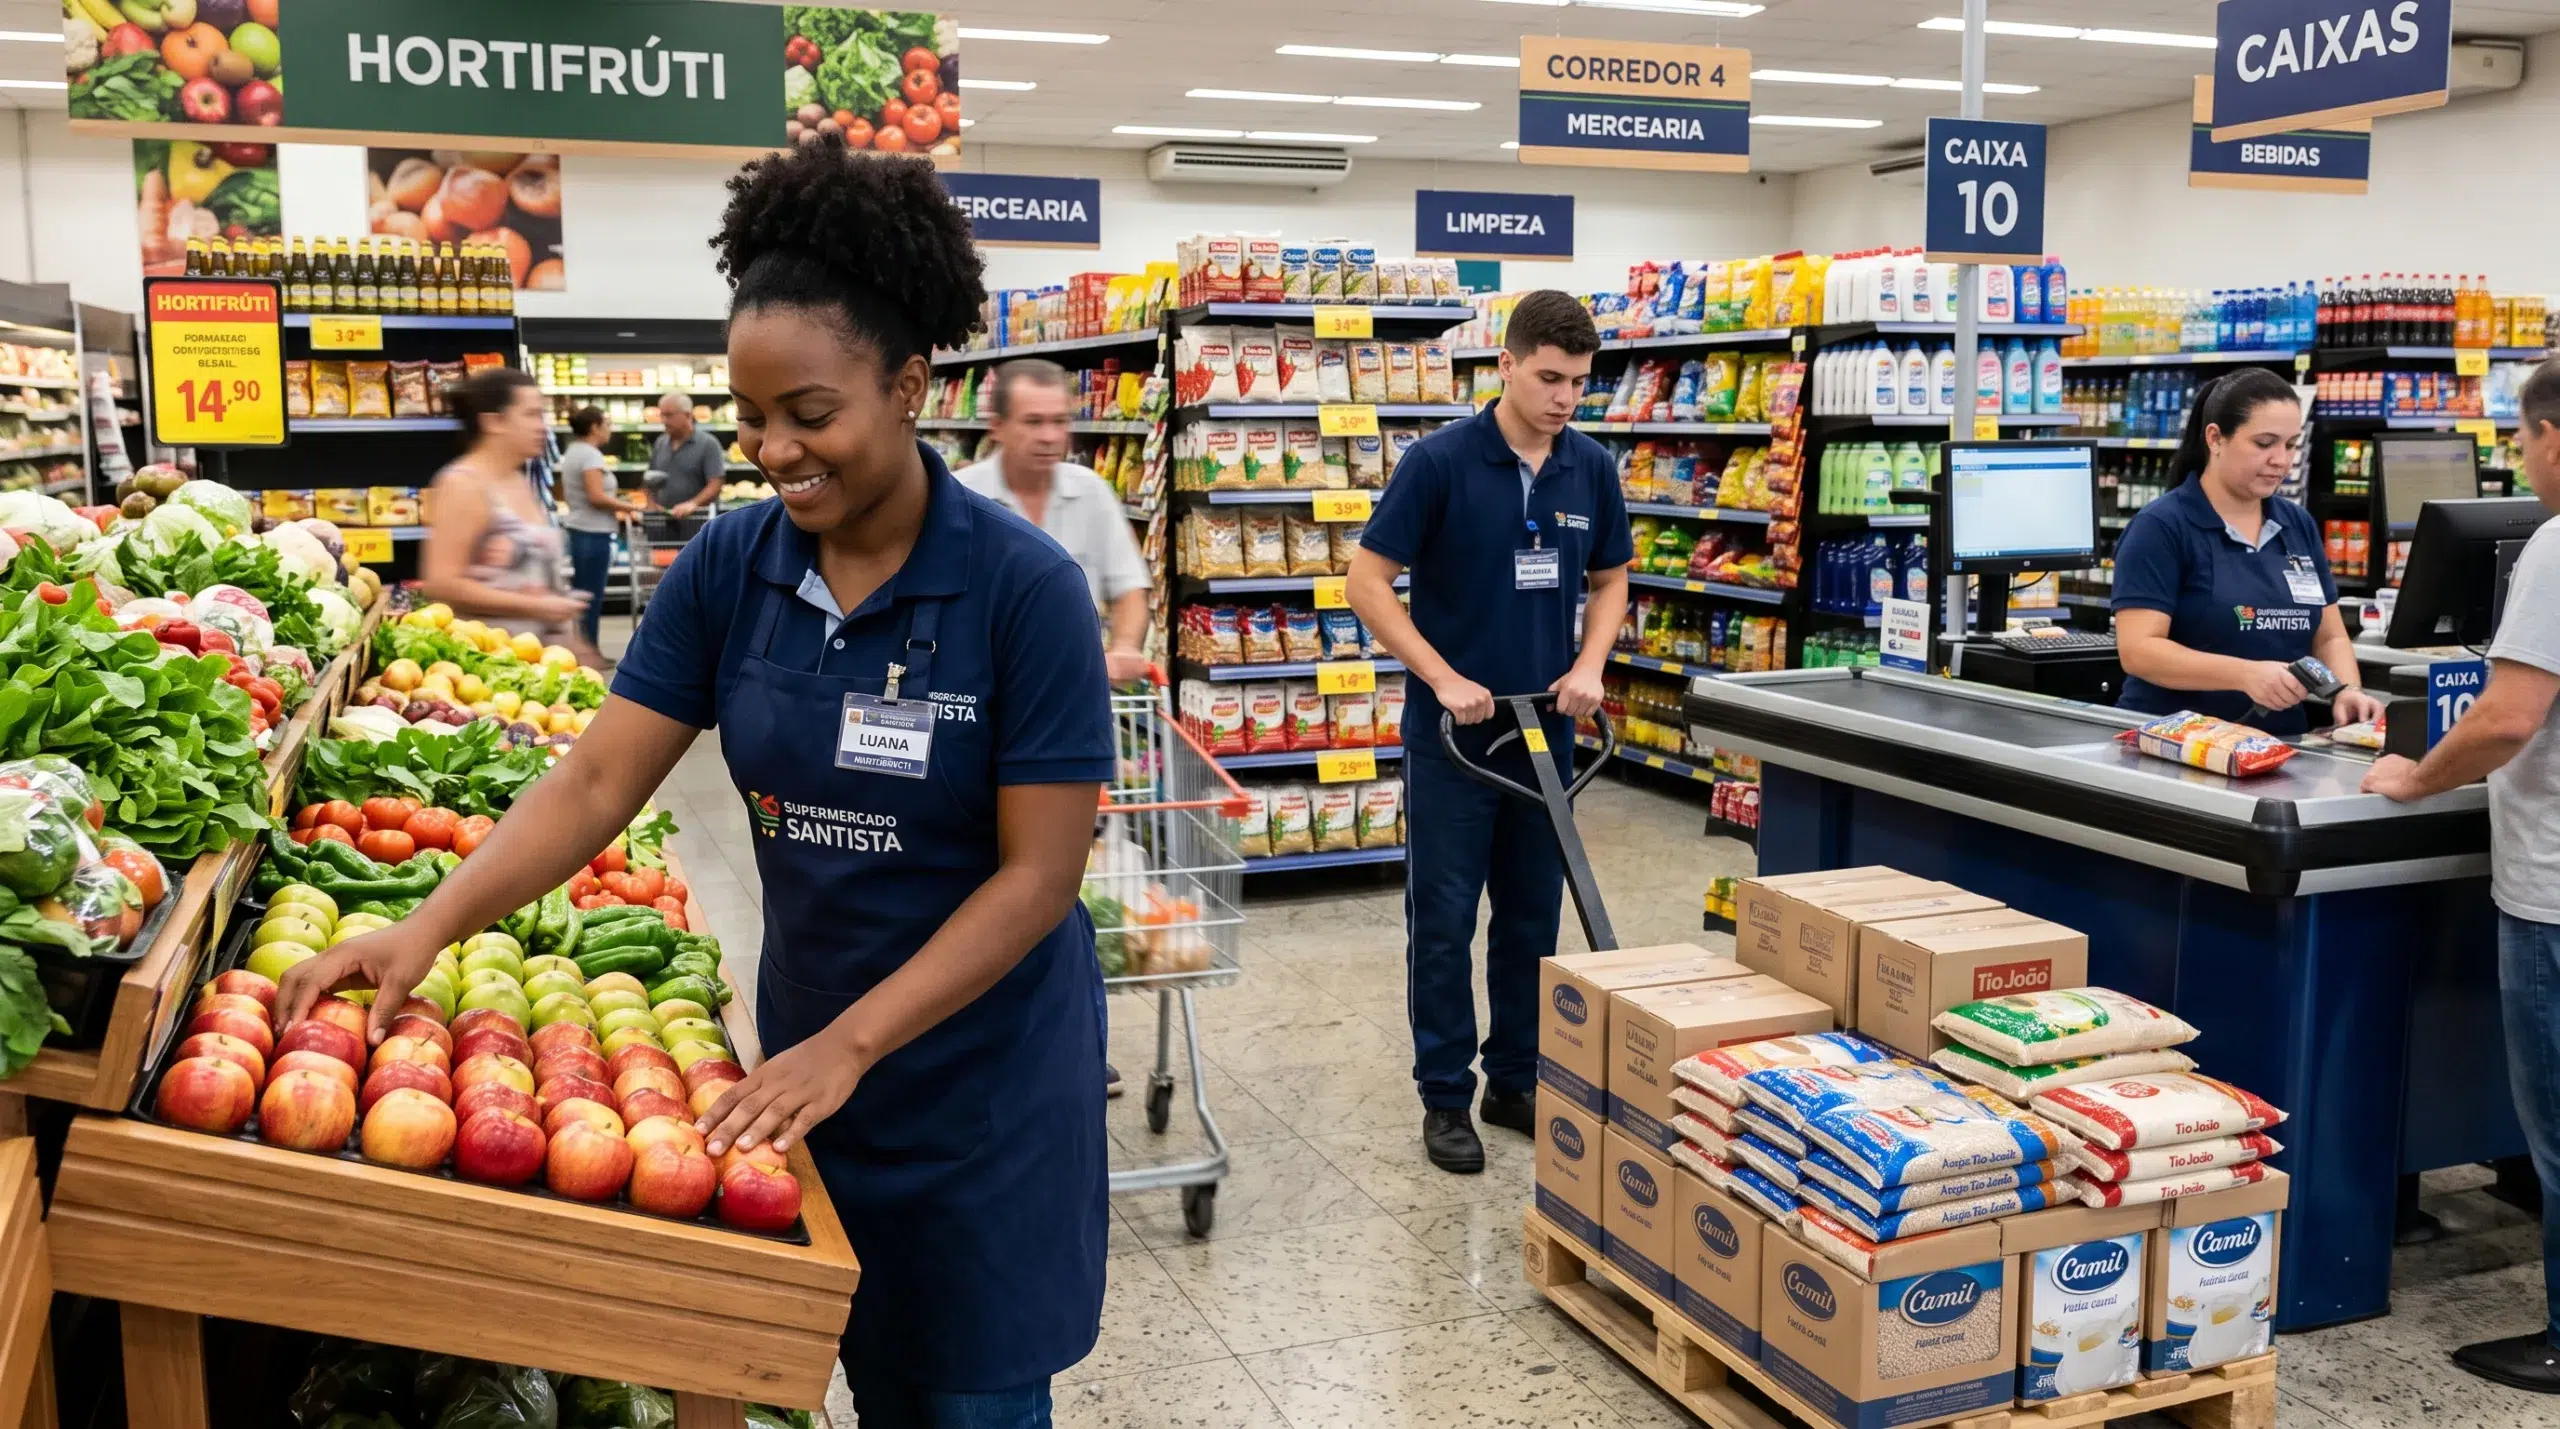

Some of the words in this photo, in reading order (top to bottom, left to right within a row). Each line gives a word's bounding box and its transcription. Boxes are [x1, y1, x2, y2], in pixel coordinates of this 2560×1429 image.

[2236, 1, 2419, 83] CAIXAS
[347, 33, 725, 99] HORTIFRÚTI
[1547, 54, 1700, 87] CORREDOR
[1710, 64, 1725, 87] 4
[1567, 113, 1705, 141] MERCEARIA
[1944, 137, 2028, 167] CAIXA
[2240, 143, 2320, 167] BEBIDAS
[948, 195, 1088, 222] ERCEARIA
[1957, 180, 2018, 236] 10
[1446, 212, 1545, 235] LIMPEZA
[157, 291, 270, 313] HORTIFRÚTI
[2256, 617, 2310, 630] SANTISTA
[2435, 671, 2479, 688] CAIXA
[938, 703, 977, 722] ISTA
[859, 733, 909, 751] LUANA
[783, 801, 897, 827] SUPERMERCADO
[786, 818, 903, 852] SANTISTA
[1977, 973, 2003, 992] Tio
[2004, 968, 2048, 988] João
[1554, 988, 1586, 1019] Camil
[1552, 1121, 1582, 1153] Camil
[2175, 1123, 2193, 1135] Tio
[2169, 1155, 2186, 1168] Tio
[1620, 1165, 1656, 1200] Camil
[2160, 1186, 2178, 1198] Tio
[1697, 1211, 1736, 1250] Camil
[2197, 1224, 2255, 1254] Camil
[2062, 1249, 2123, 1281] Camil
[1787, 1270, 1833, 1312] Camil
[1909, 1282, 1975, 1313] Camil
